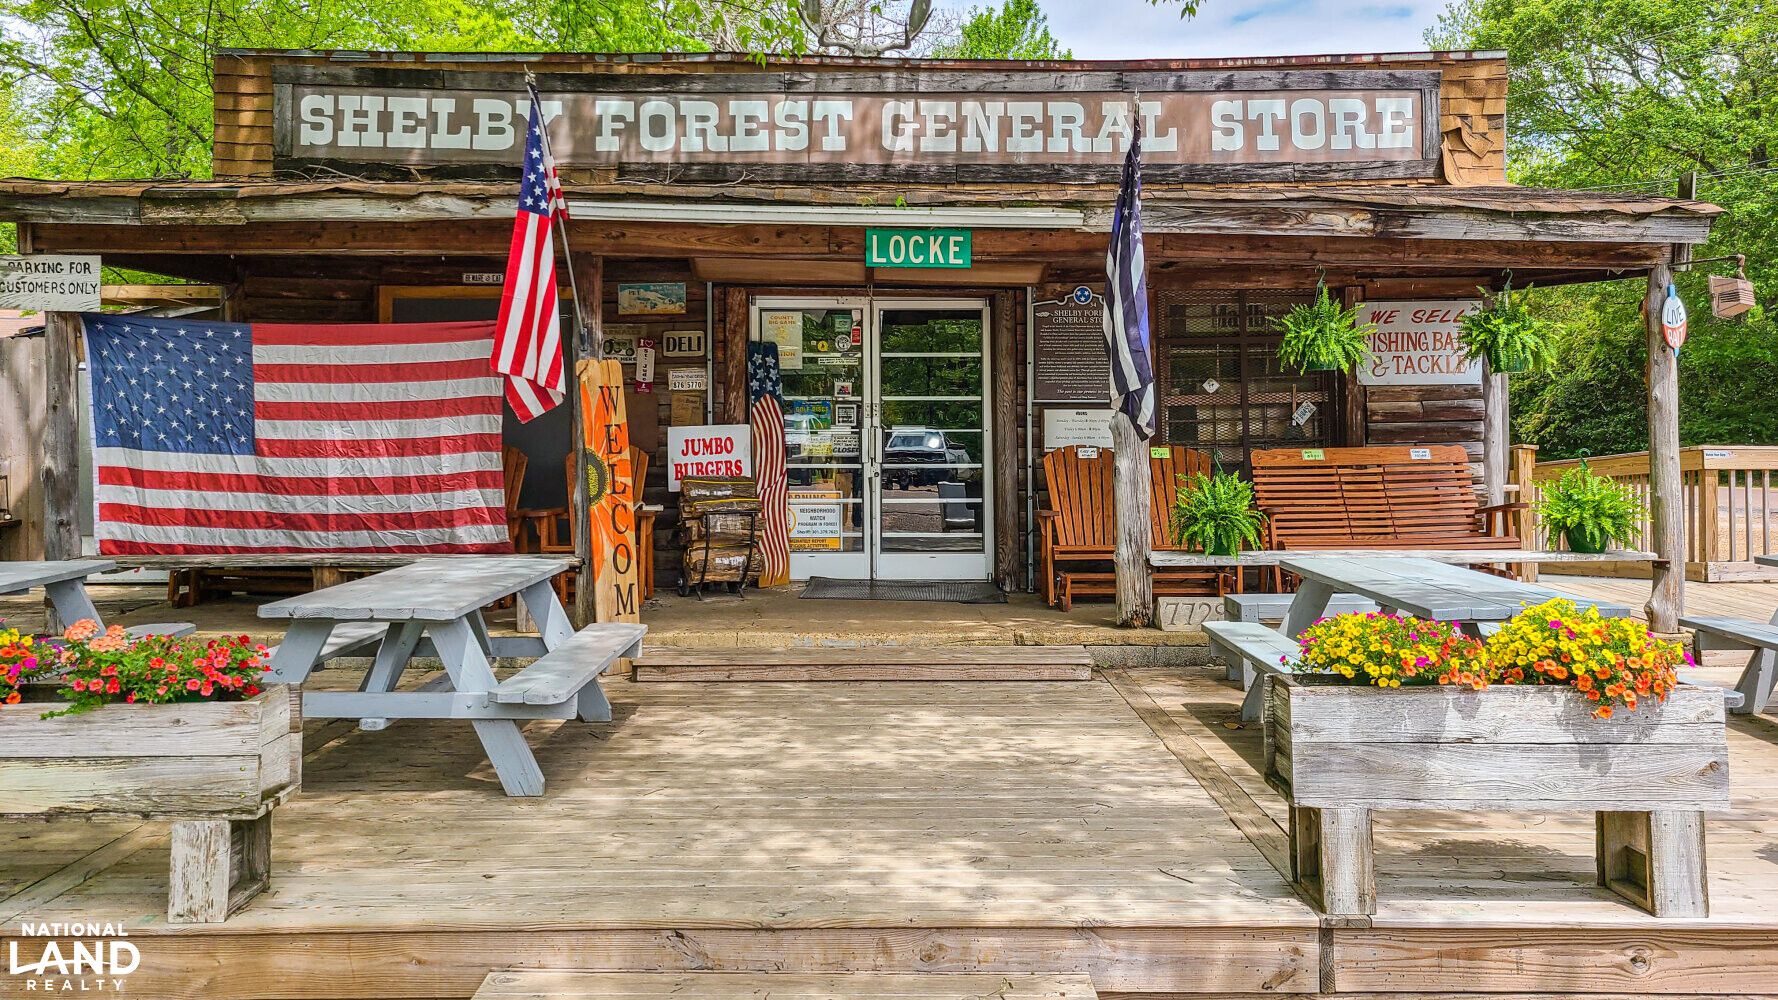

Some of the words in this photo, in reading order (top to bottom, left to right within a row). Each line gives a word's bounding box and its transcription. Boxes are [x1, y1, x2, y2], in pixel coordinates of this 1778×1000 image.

[595, 99, 854, 152] FOREST
[881, 100, 1178, 153] GENERAL
[1211, 98, 1414, 151] STORE
[872, 235, 964, 264] LOCKE
[8, 261, 64, 274] PARKING
[69, 261, 92, 274] FOR
[0, 281, 66, 295] CUSTOMERS
[68, 282, 98, 295] ONLY
[1053, 316, 1088, 324] GENERAL
[1090, 316, 1103, 324] STO
[1370, 309, 1400, 324] WE
[1411, 309, 1465, 324] SELL
[1667, 305, 1684, 326] LIVE
[665, 336, 702, 353] DELI
[1363, 331, 1430, 353] ISHING
[1432, 331, 1466, 351] BAI
[1667, 326, 1685, 347] BAIT
[1371, 356, 1390, 377] &
[1392, 354, 1468, 375] TACKLE
[673, 381, 685, 389] 876
[687, 380, 702, 389] 5770
[681, 436, 734, 456] JUMBO
[674, 459, 743, 481] BURGERS
[599, 385, 636, 617] WELCOM
[1164, 601, 1225, 626] 7729
